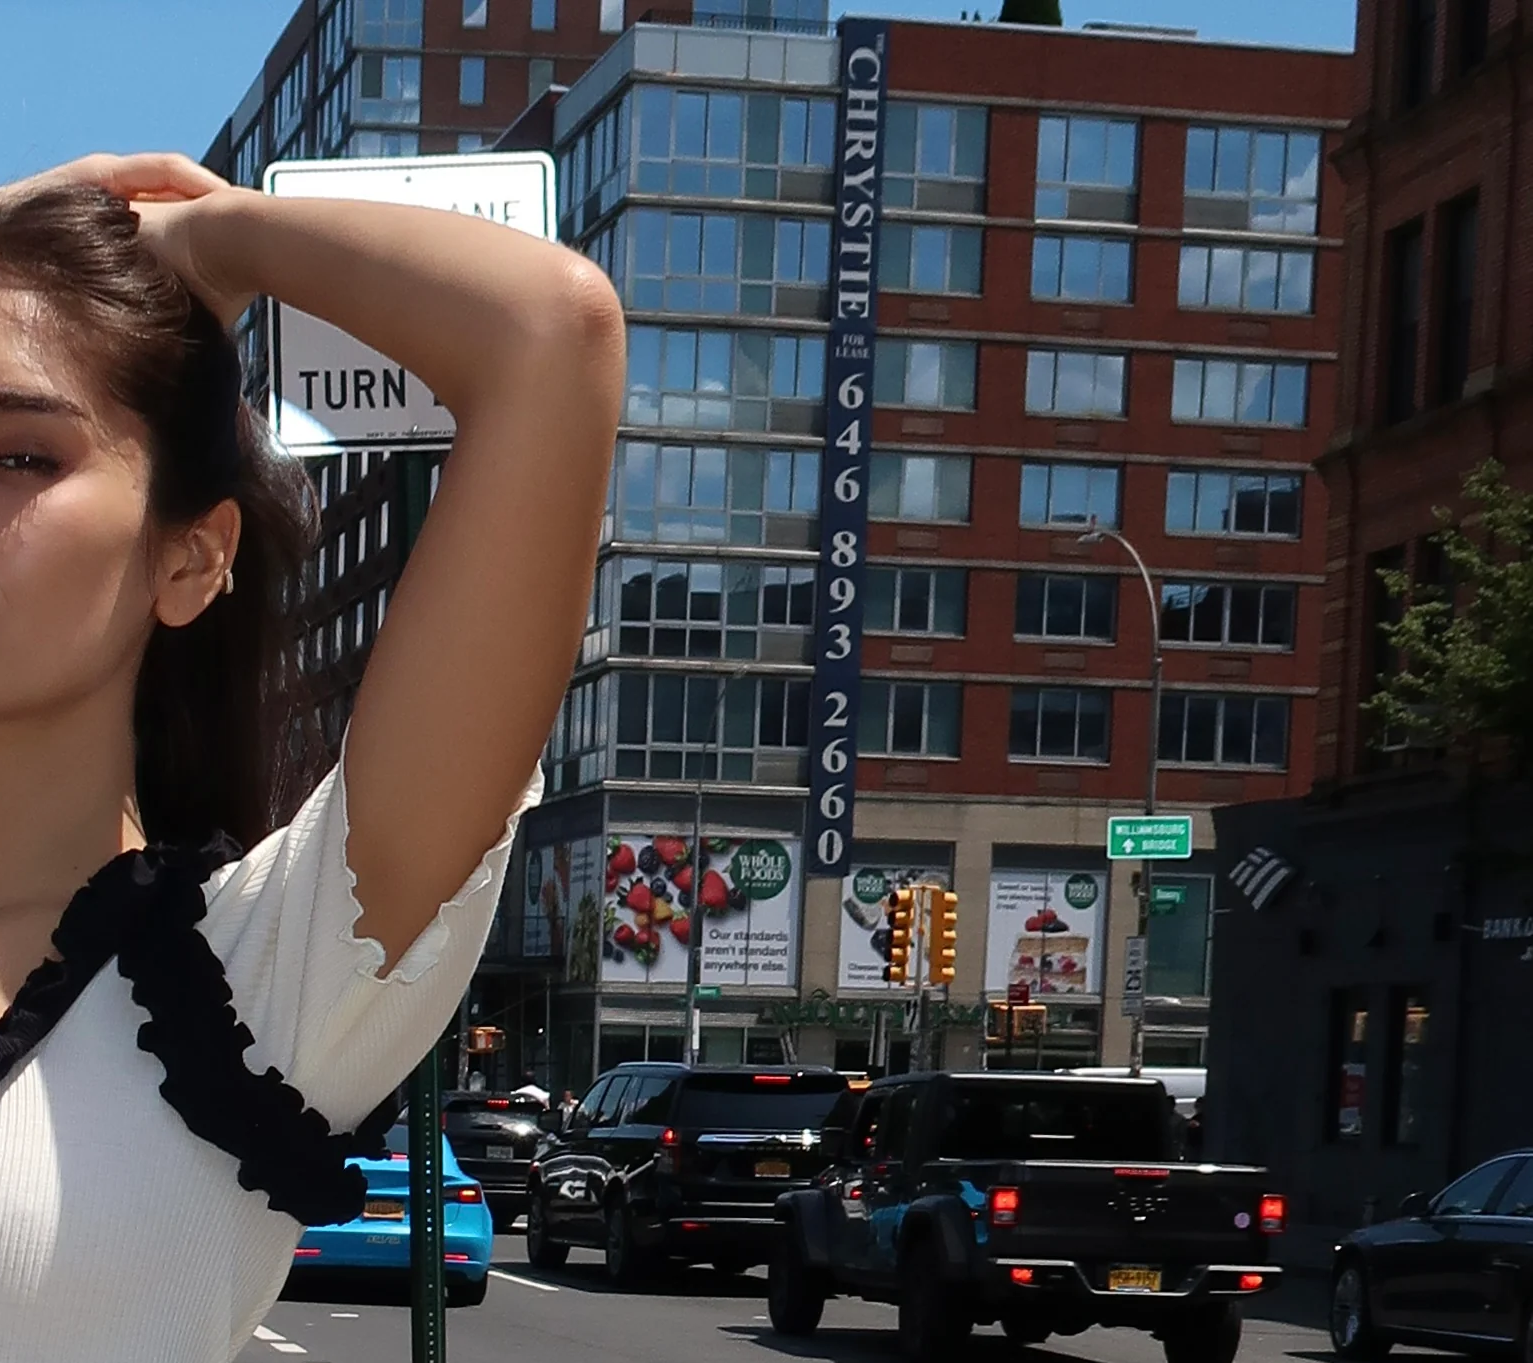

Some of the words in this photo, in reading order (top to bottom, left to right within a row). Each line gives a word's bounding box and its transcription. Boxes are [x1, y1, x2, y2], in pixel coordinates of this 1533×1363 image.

[837, 46, 881, 319] CHRYSTIE
[842, 333, 865, 346] FOR
[834, 345, 870, 359] LEASE
[298, 368, 407, 410] TURN
[1115, 824, 1186, 835] WILLIAMSBURG
[1142, 839, 1177, 851] BRIDGE
[738, 851, 785, 869] WHOLE
[740, 866, 784, 880] FOODS
[709, 928, 732, 940] Our
[734, 930, 788, 941] standards
[705, 946, 736, 956] aren't
[738, 946, 788, 957] standard
[704, 962, 759, 973] anywhere
[761, 962, 787, 972] else.
